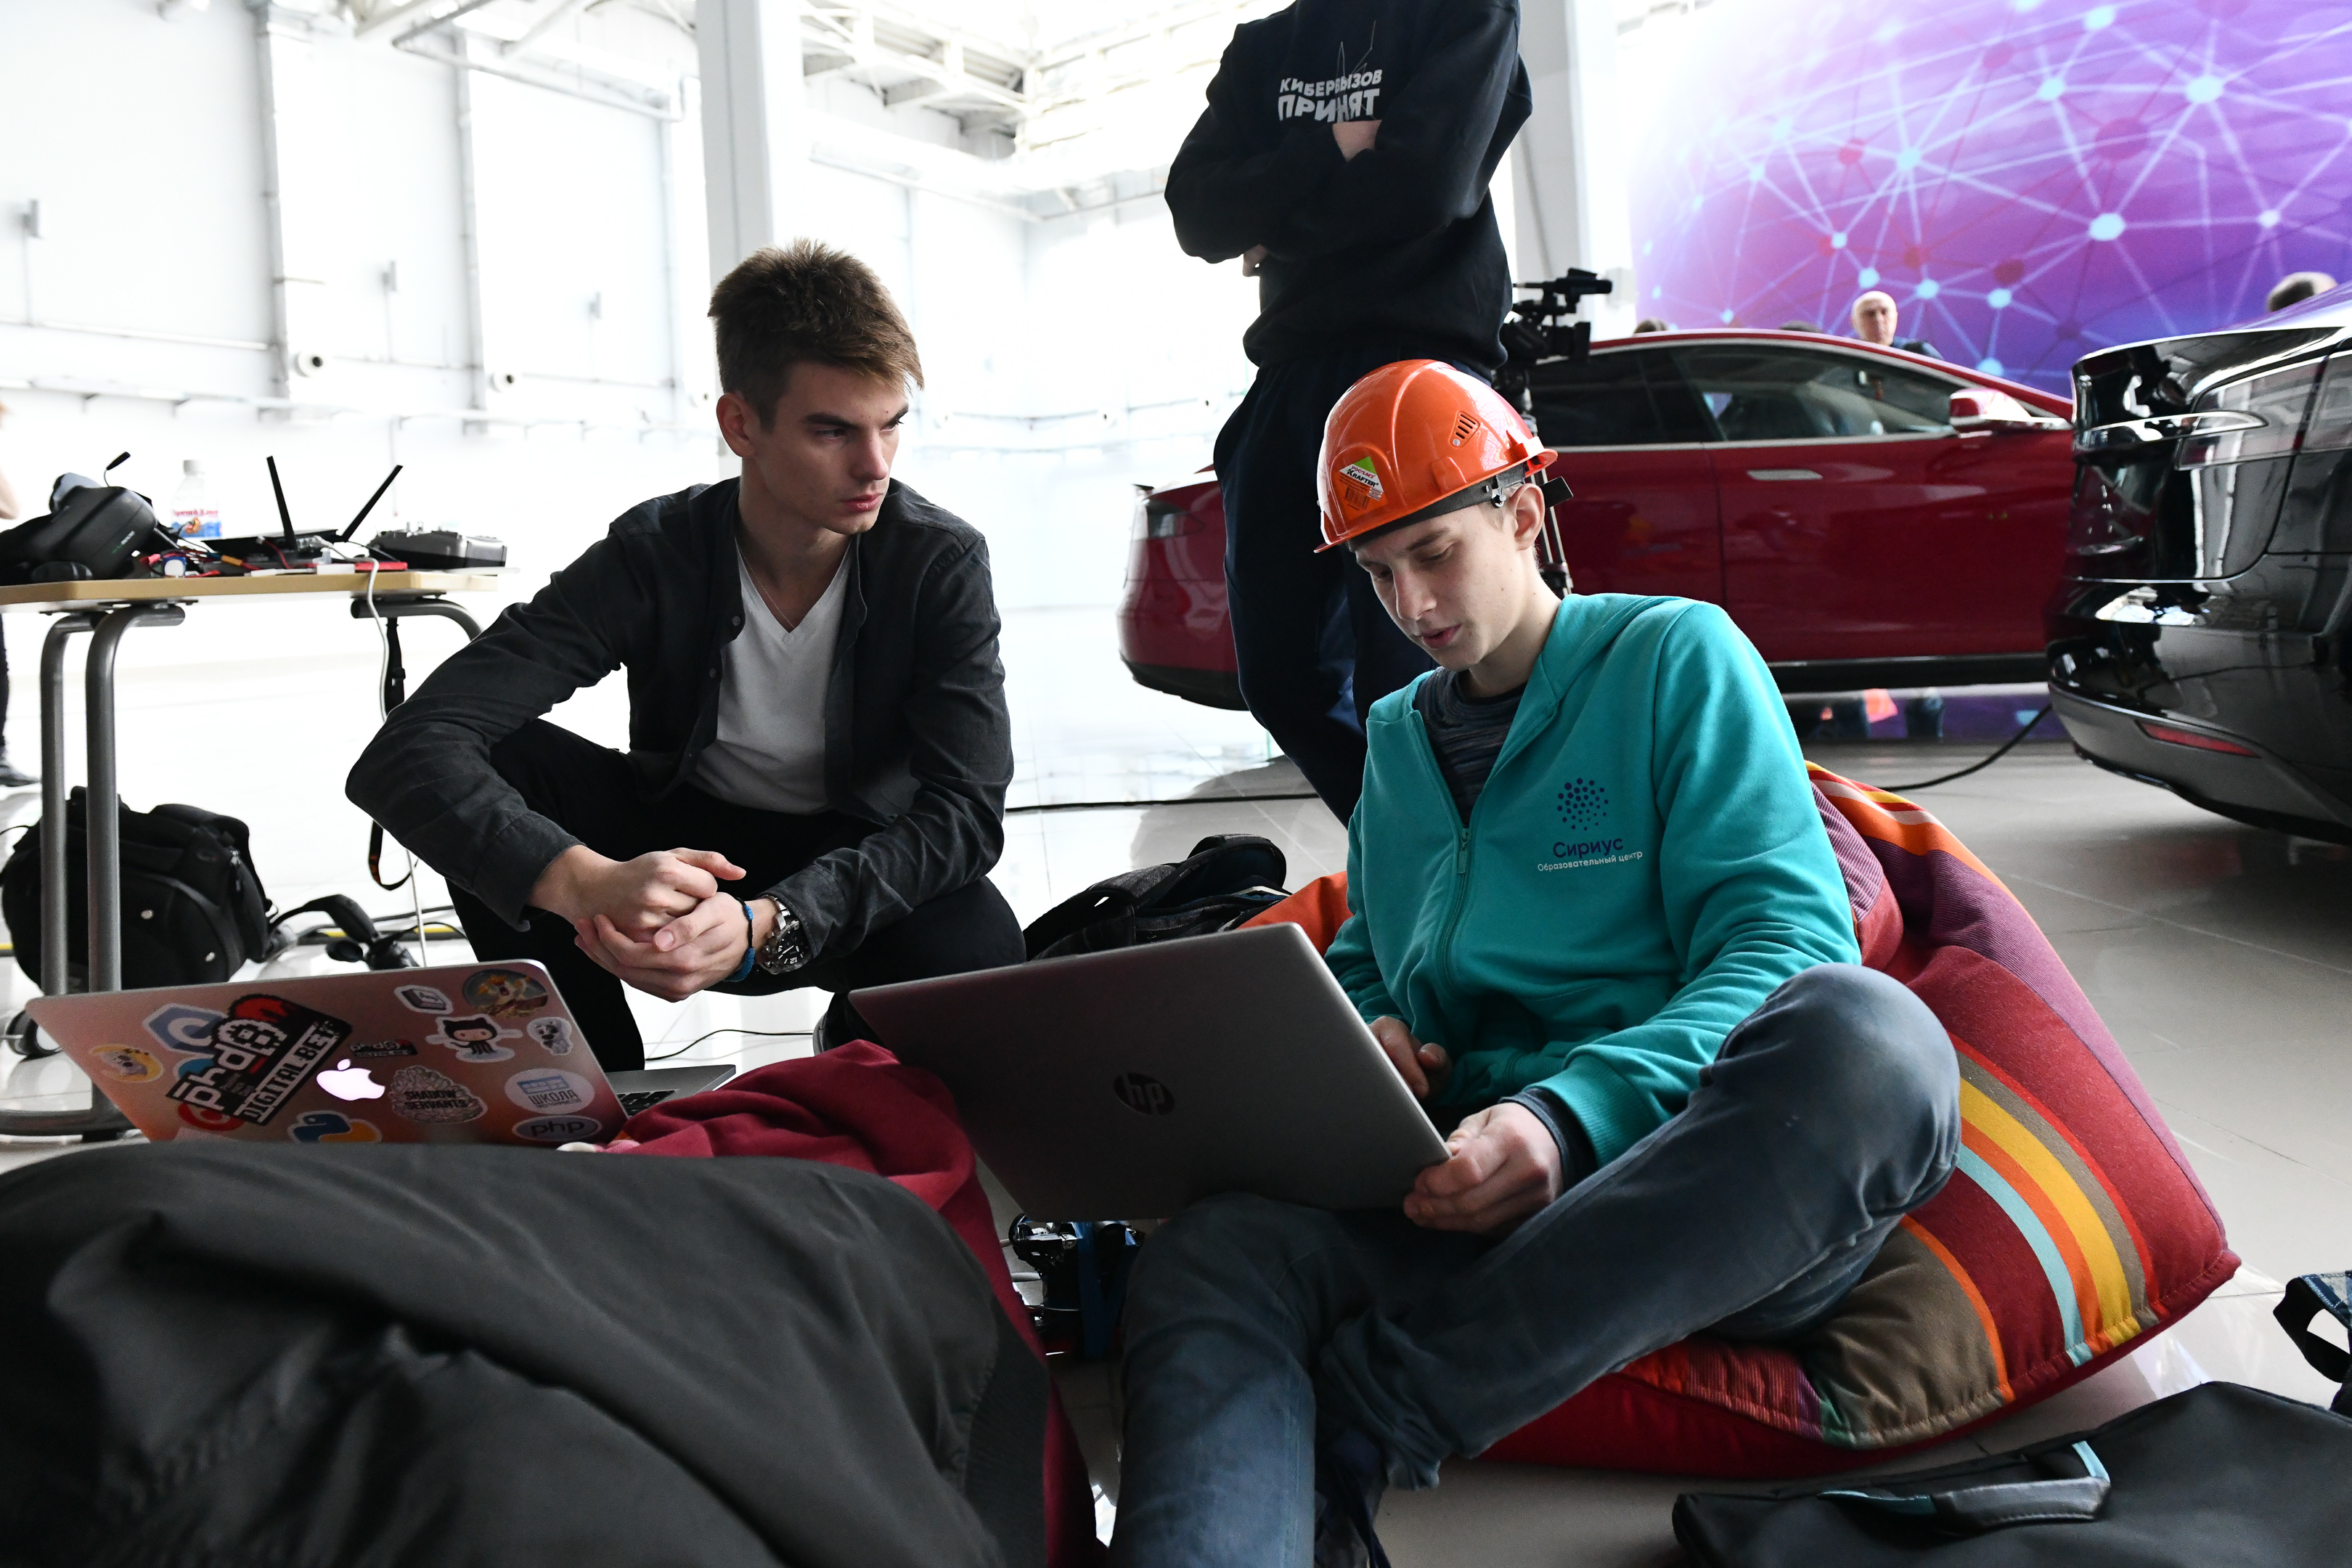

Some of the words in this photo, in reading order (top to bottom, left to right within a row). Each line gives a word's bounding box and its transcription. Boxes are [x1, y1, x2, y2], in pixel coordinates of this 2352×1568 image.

[1279, 69, 1383, 97] КИБЕРВЫЗОВ
[1278, 88, 1380, 123] ПРИНЯТ
[1553, 838, 1624, 859] Сириус
[1538, 855, 1617, 872] Образовательный
[1619, 851, 1643, 862] центр
[242, 1059, 309, 1118] DIGITAL
[404, 1090, 457, 1100] SHADOW
[528, 1089, 579, 1106] ШКОЛА
[403, 1100, 469, 1111] SERVANTS
[530, 1121, 585, 1138] php
